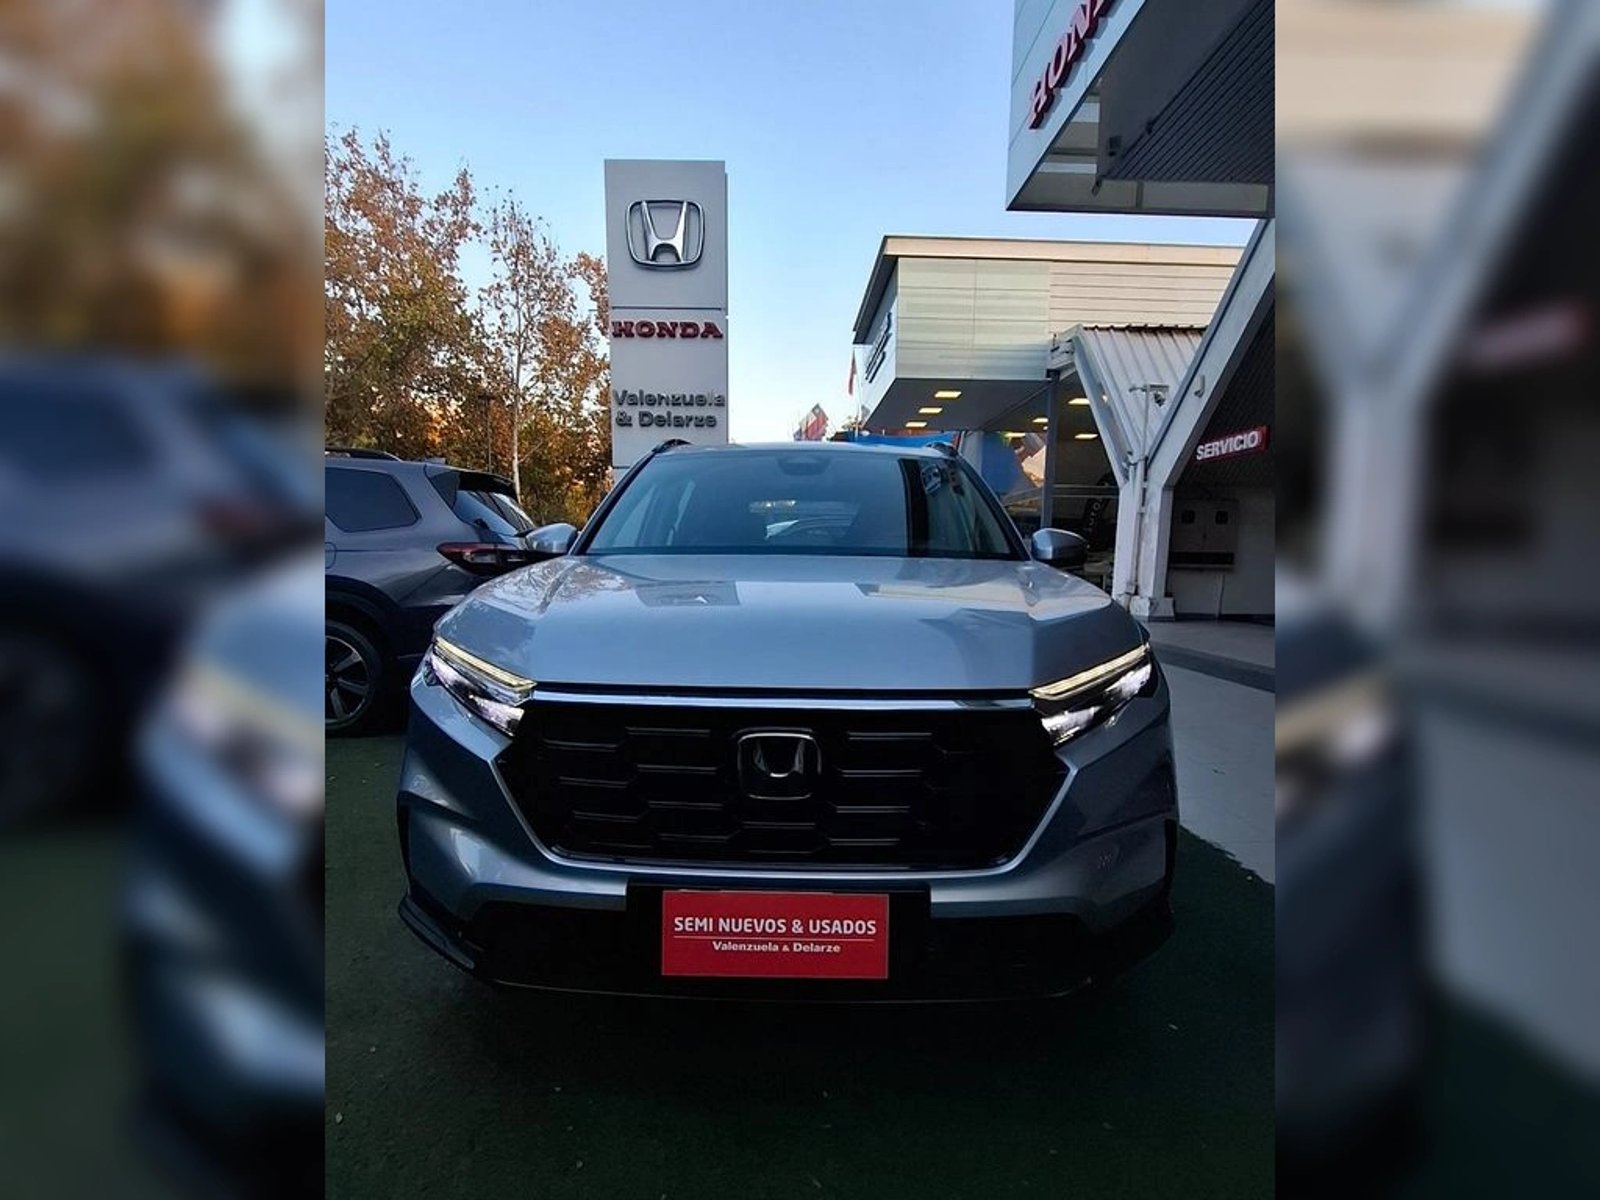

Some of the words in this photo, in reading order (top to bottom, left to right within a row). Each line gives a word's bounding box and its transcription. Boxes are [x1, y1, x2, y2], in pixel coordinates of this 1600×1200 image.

[611, 321, 723, 339] HONDA
[613, 389, 725, 407] Valenzuela
[615, 411, 633, 427] &
[639, 411, 717, 428] Delarze
[1196, 430, 1260, 460] SERVICIO
[674, 917, 713, 932] SEMI
[719, 917, 786, 933] NUEVOS
[792, 919, 804, 933] &
[809, 920, 877, 935] USADOS
[713, 941, 779, 952] Valenzuela
[782, 944, 790, 952] &
[793, 943, 841, 953] Delarze
